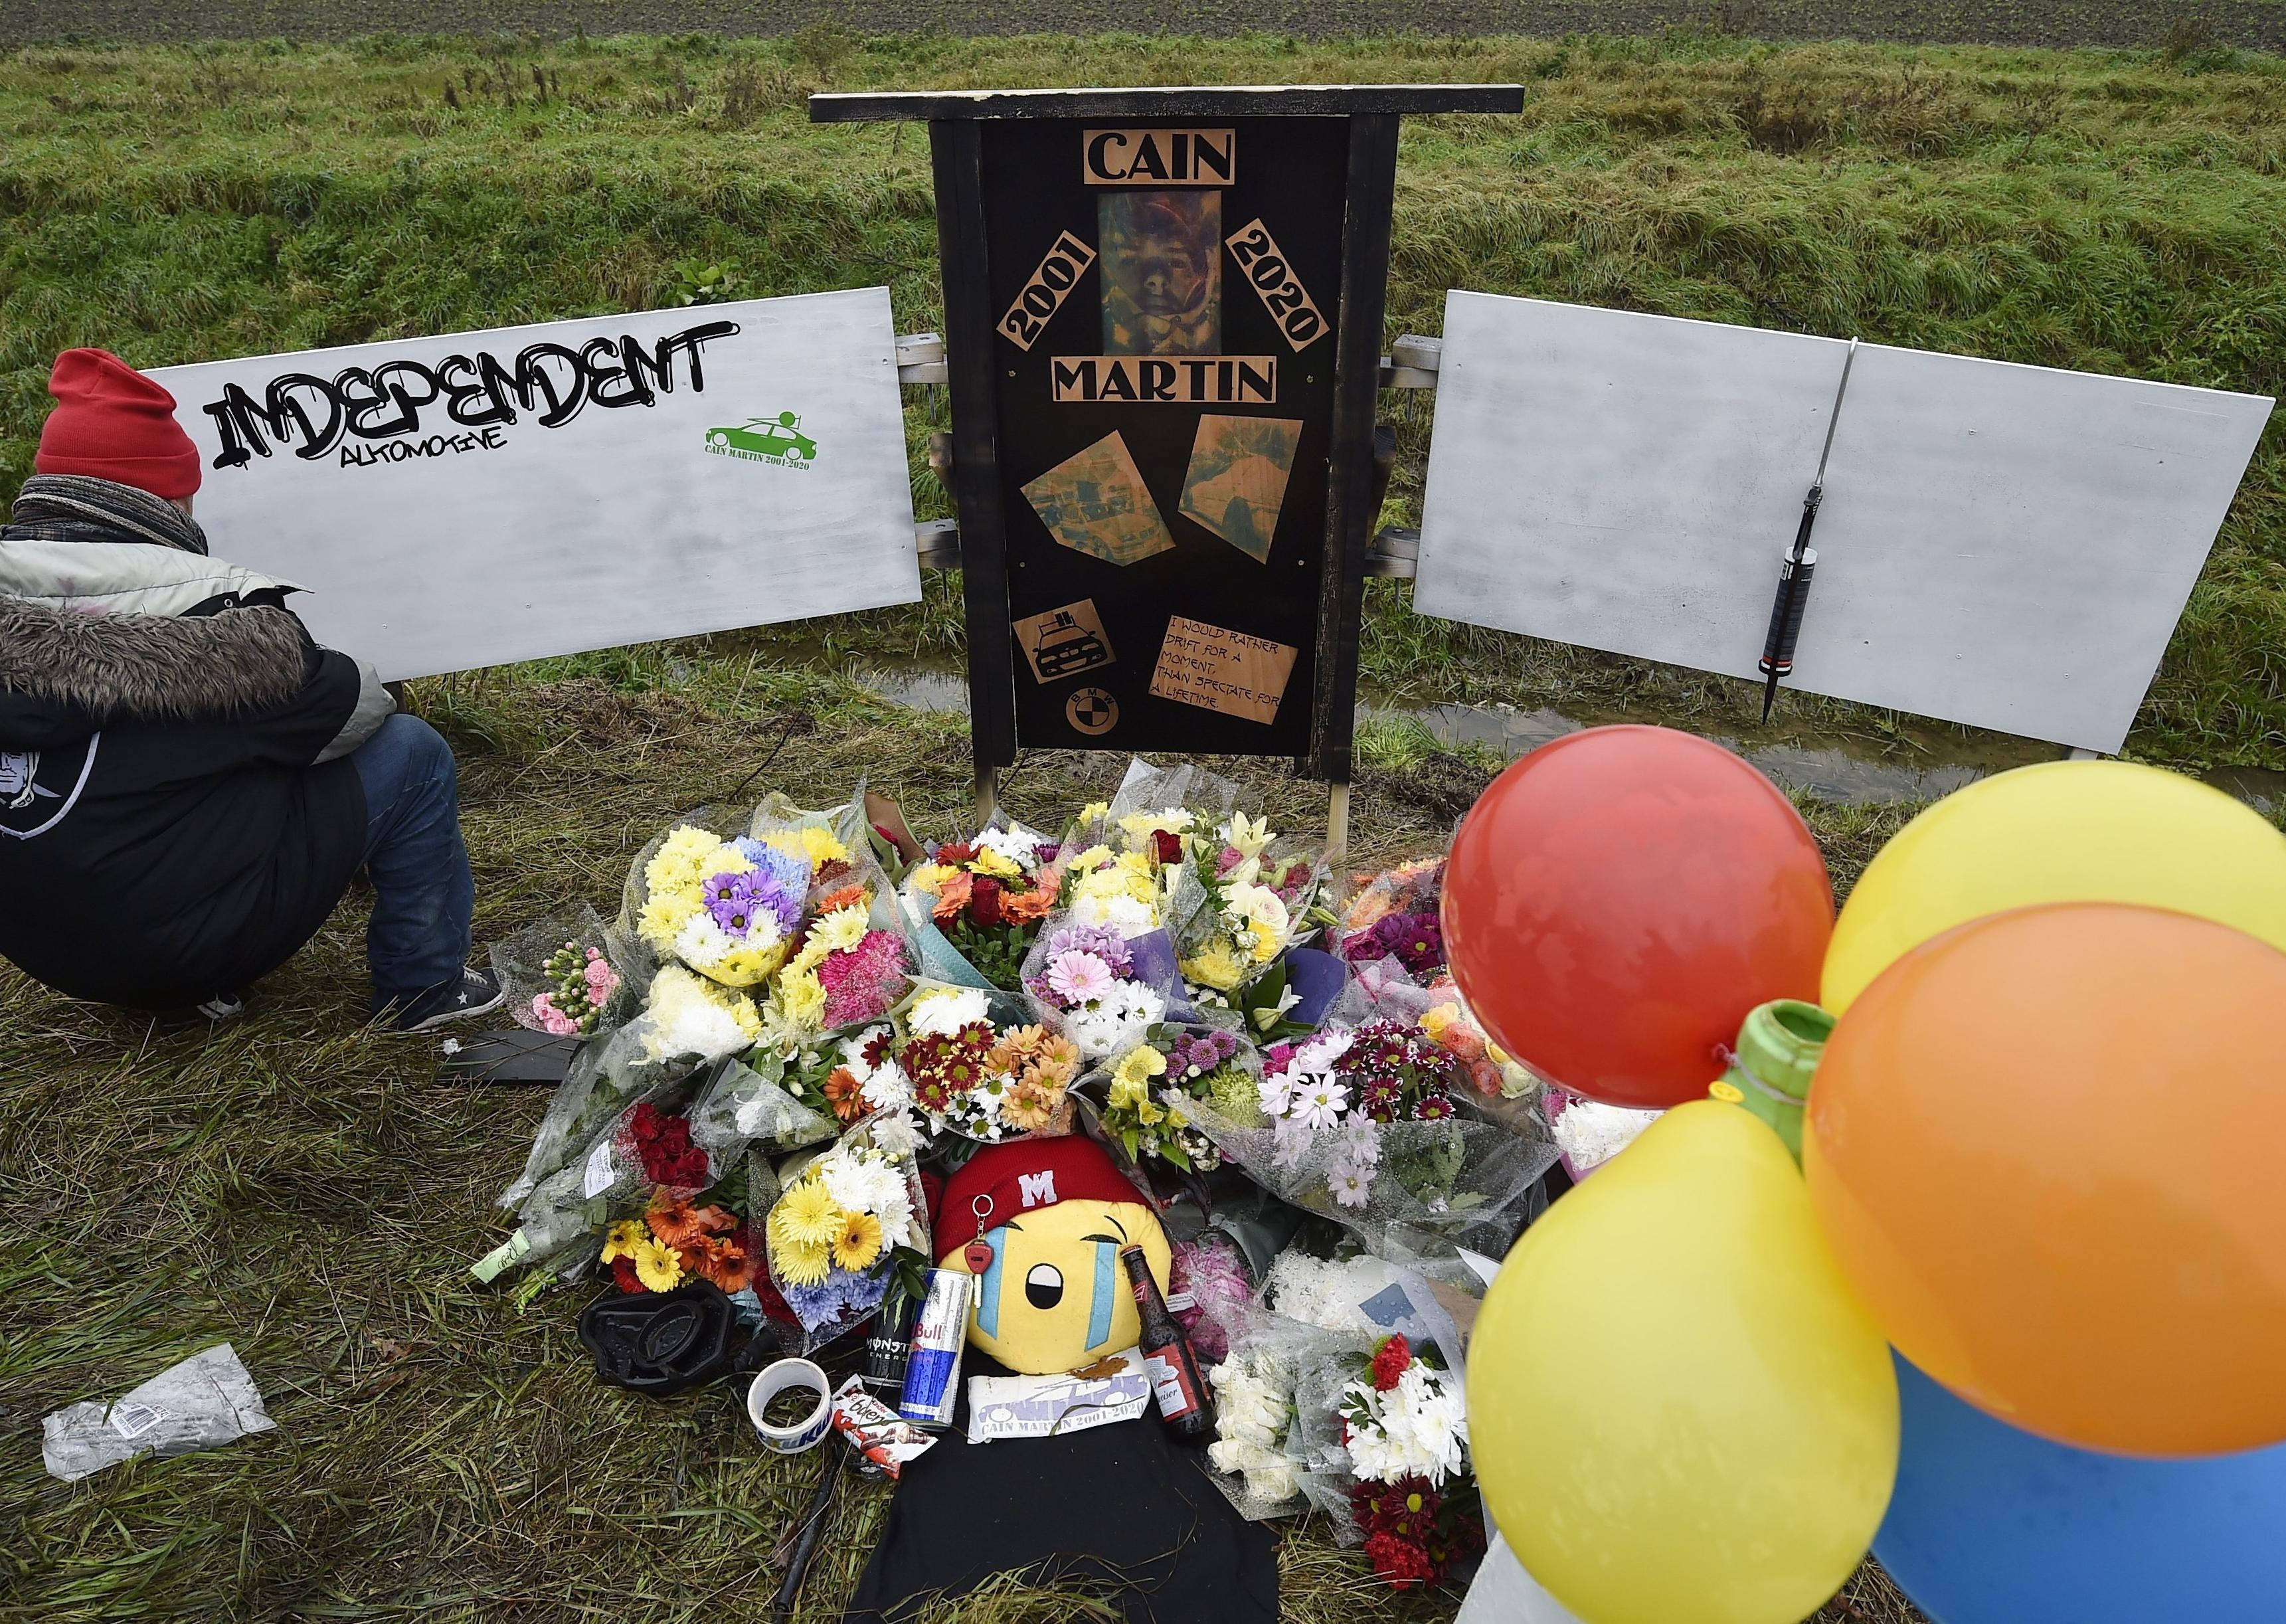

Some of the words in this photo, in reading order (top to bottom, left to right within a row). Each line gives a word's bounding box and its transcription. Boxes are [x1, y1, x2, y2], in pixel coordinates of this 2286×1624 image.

[1087, 132, 1231, 181] CAIN
[1006, 236, 1089, 344] 2001
[1236, 228, 1320, 342] 2020
[203, 320, 741, 469] INDEPENDENT
[1053, 360, 1273, 402] MARTIN
[340, 425, 509, 468] AUTOMOTIVE
[705, 444, 727, 456] CAIN
[728, 448, 764, 464] MARTIN
[764, 456, 810, 470] 2001-2020
[1171, 617, 1177, 627] I
[1182, 621, 1225, 638] WOULD
[1229, 632, 1279, 654] RATHER
[1202, 645, 1228, 659] FOR
[1231, 652, 1241, 663] A
[1071, 689, 1114, 705] BMW
[1150, 683, 1160, 693] A
[1158, 666, 1191, 684] THAN
[1195, 676, 1253, 699] SPECTATE
[1255, 693, 1280, 707] FOR
[1018, 1170, 1057, 1208] M
[866, 1336, 910, 1354] MONST
[916, 1322, 942, 1340] Bull
[869, 1352, 907, 1362] ENERG
[849, 1399, 885, 1423] buen
[982, 1421, 1014, 1435] CAIN
[1018, 1418, 1072, 1432] MARTIN
[1076, 1401, 1144, 1426] 2001-2020
